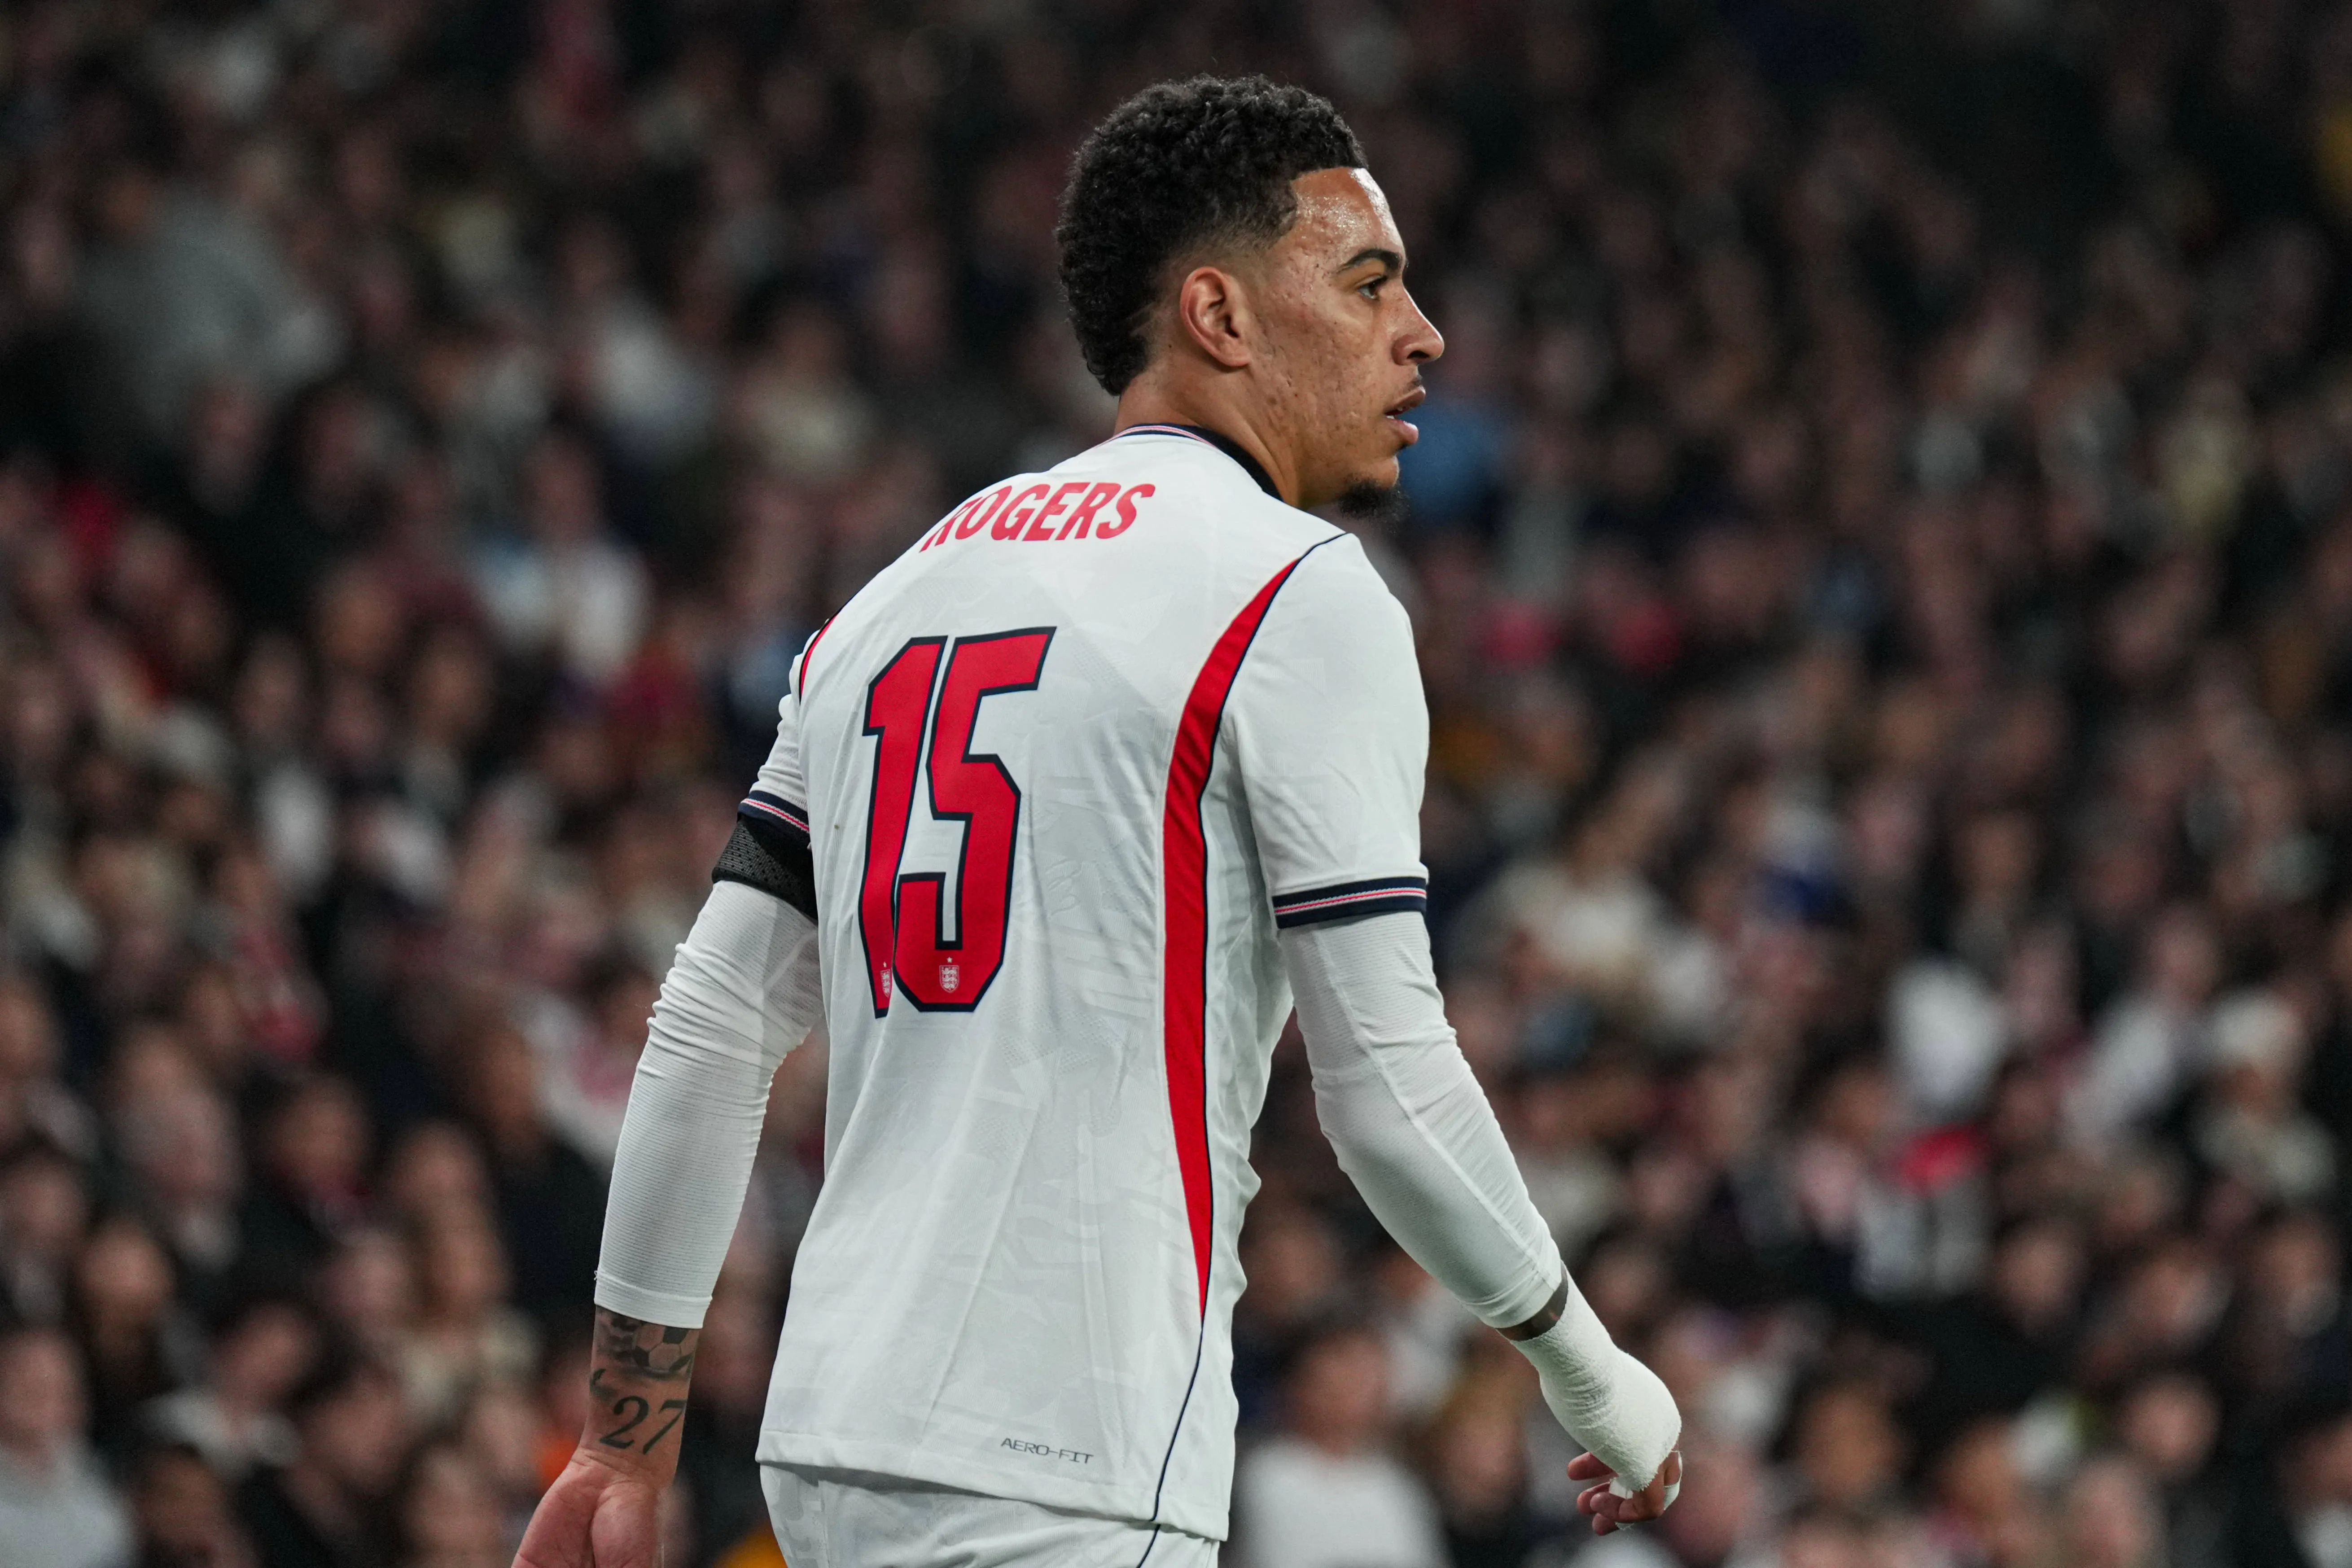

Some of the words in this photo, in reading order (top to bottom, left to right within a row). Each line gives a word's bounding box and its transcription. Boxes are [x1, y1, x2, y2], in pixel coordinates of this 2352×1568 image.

[858, 626, 1057, 1019] 15
[600, 1396, 688, 1454] 27
[1001, 1437, 1094, 1464] AERO-FIT
